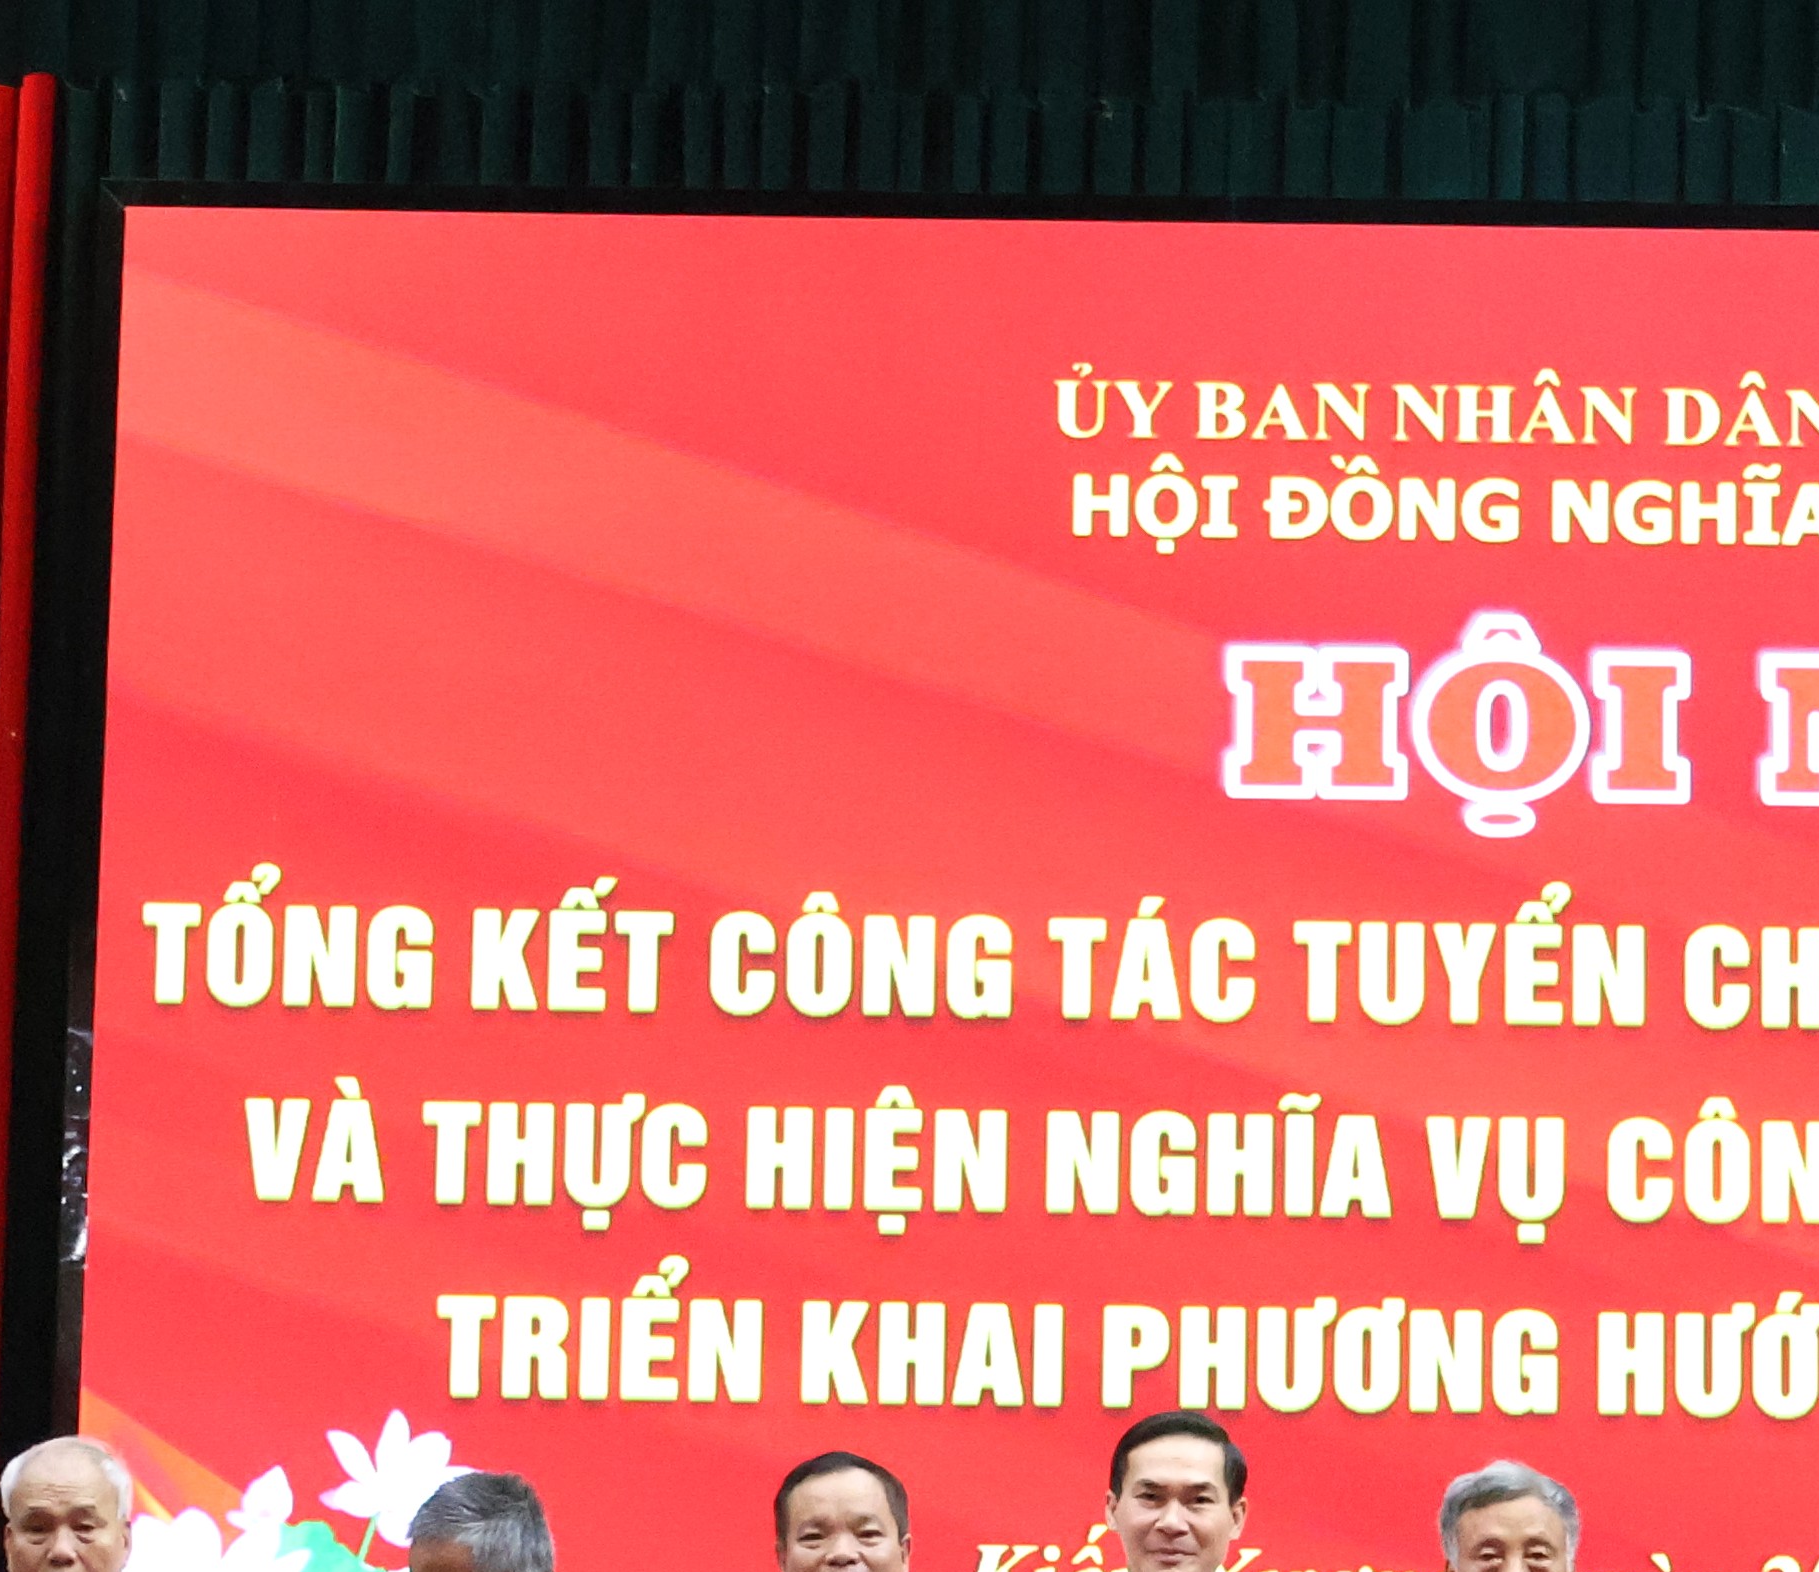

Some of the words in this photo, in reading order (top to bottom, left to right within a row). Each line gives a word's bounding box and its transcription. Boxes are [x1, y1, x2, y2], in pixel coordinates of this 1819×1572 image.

[1053, 362, 1175, 441] ỦY
[1193, 379, 1374, 444] BAN
[1391, 367, 1638, 447] NHÂN
[1071, 451, 1241, 555] HỘI
[1262, 454, 1522, 545] ĐỒNG
[1223, 612, 1692, 839] HỘI
[142, 862, 435, 1010] TỔNG
[469, 876, 675, 1013] KẾT
[708, 890, 1015, 1020] CÔNG
[1046, 895, 1258, 1024] TÁC
[1292, 881, 1647, 1028] TUYỂN
[244, 1076, 385, 1204] VÀ
[421, 1092, 709, 1231] THỰC
[744, 1085, 1009, 1236] HIỆN
[1044, 1092, 1393, 1219] NGHĨA
[1424, 1118, 1568, 1245] VỤ
[436, 1254, 765, 1404] TRIỂN
[799, 1300, 1065, 1408] KHAI
[1100, 1300, 1560, 1416] PHƯƠNG
